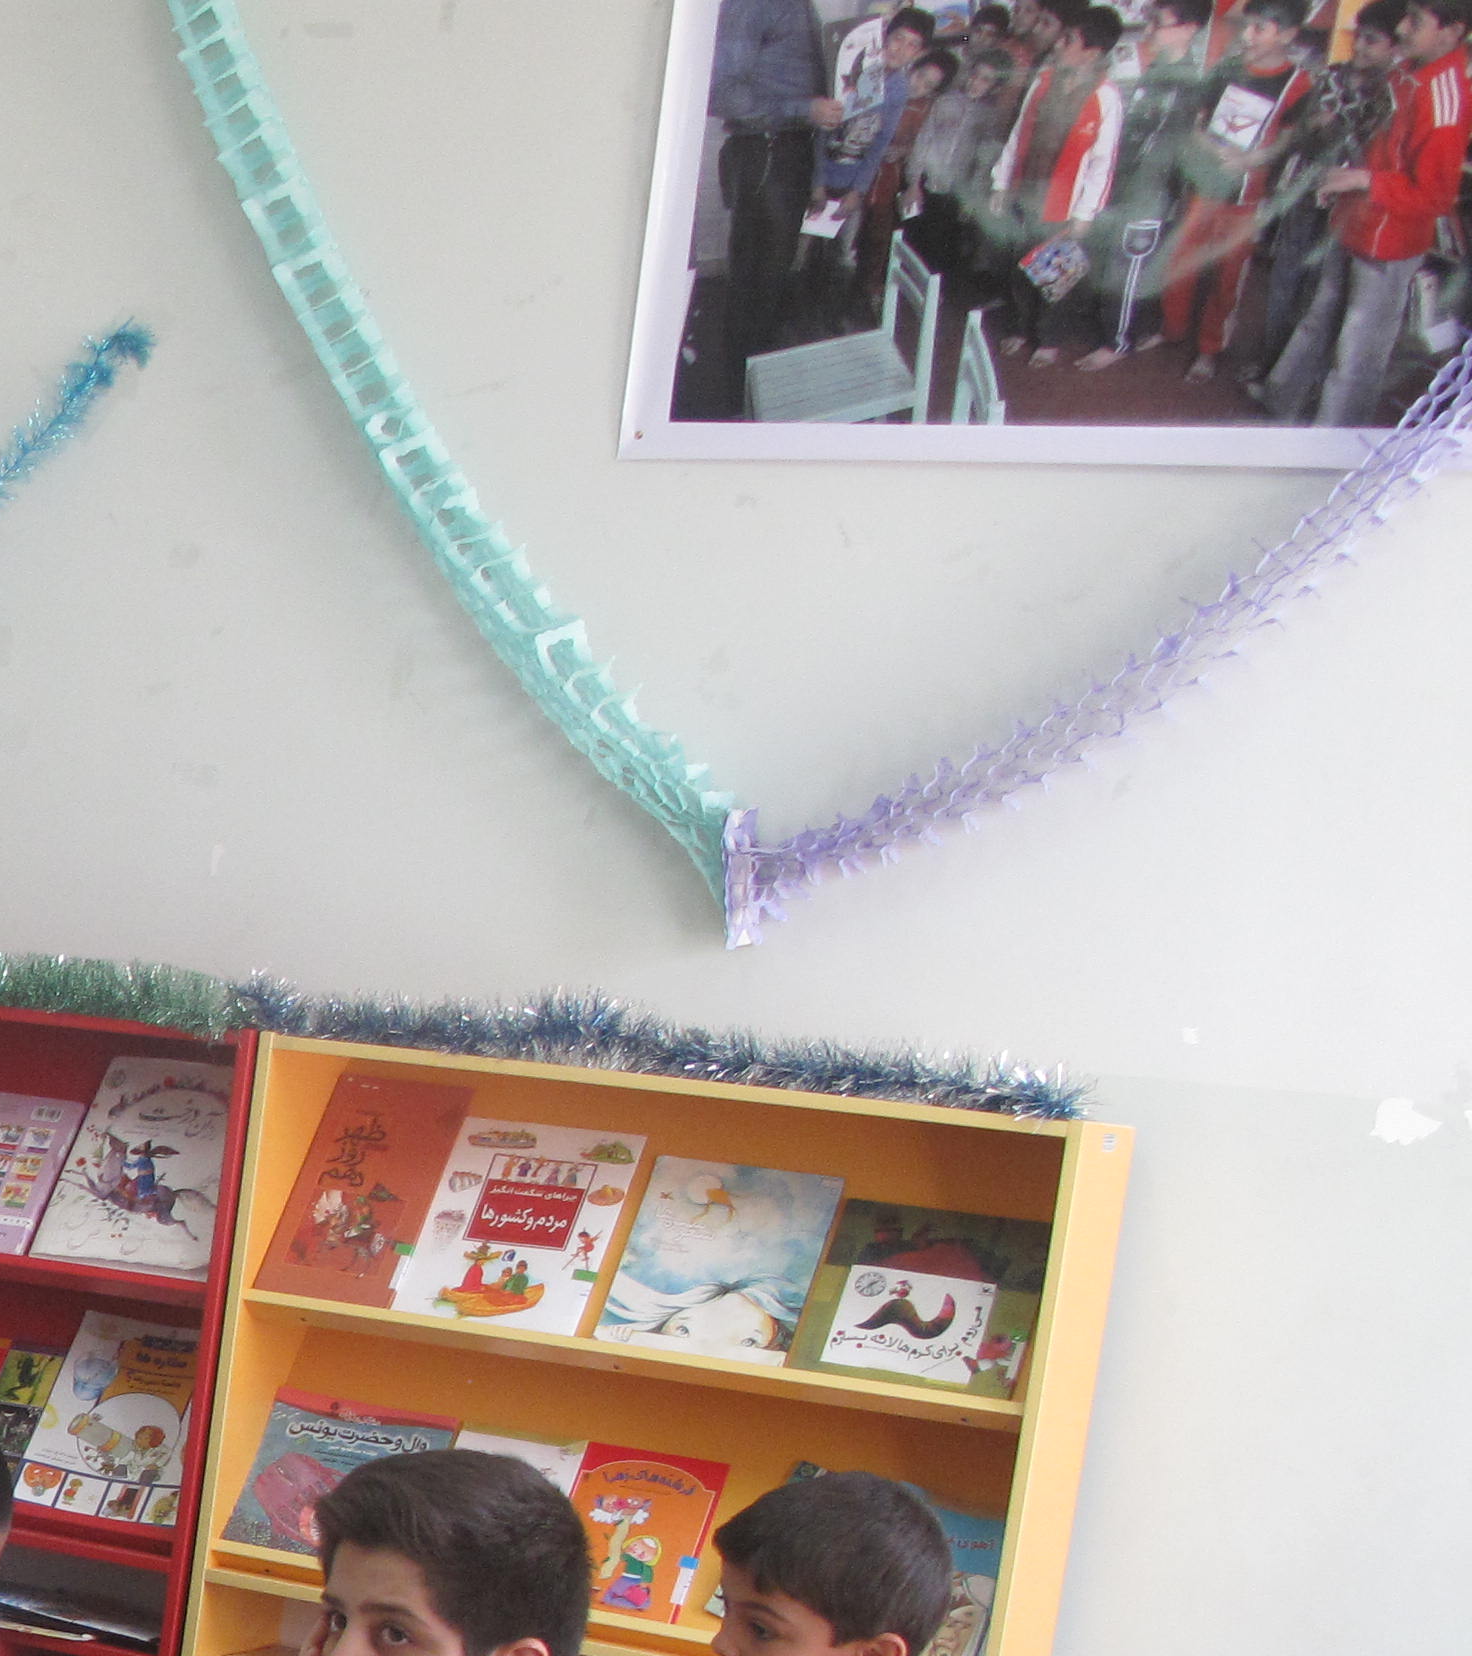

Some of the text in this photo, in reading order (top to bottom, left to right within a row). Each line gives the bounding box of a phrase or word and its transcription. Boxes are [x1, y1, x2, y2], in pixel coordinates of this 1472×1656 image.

[480, 1202, 533, 1228] کشورها
[533, 1213, 568, 1233] مردم
[288, 1420, 338, 1439] یونس
[337, 1429, 394, 1448] حضرت
